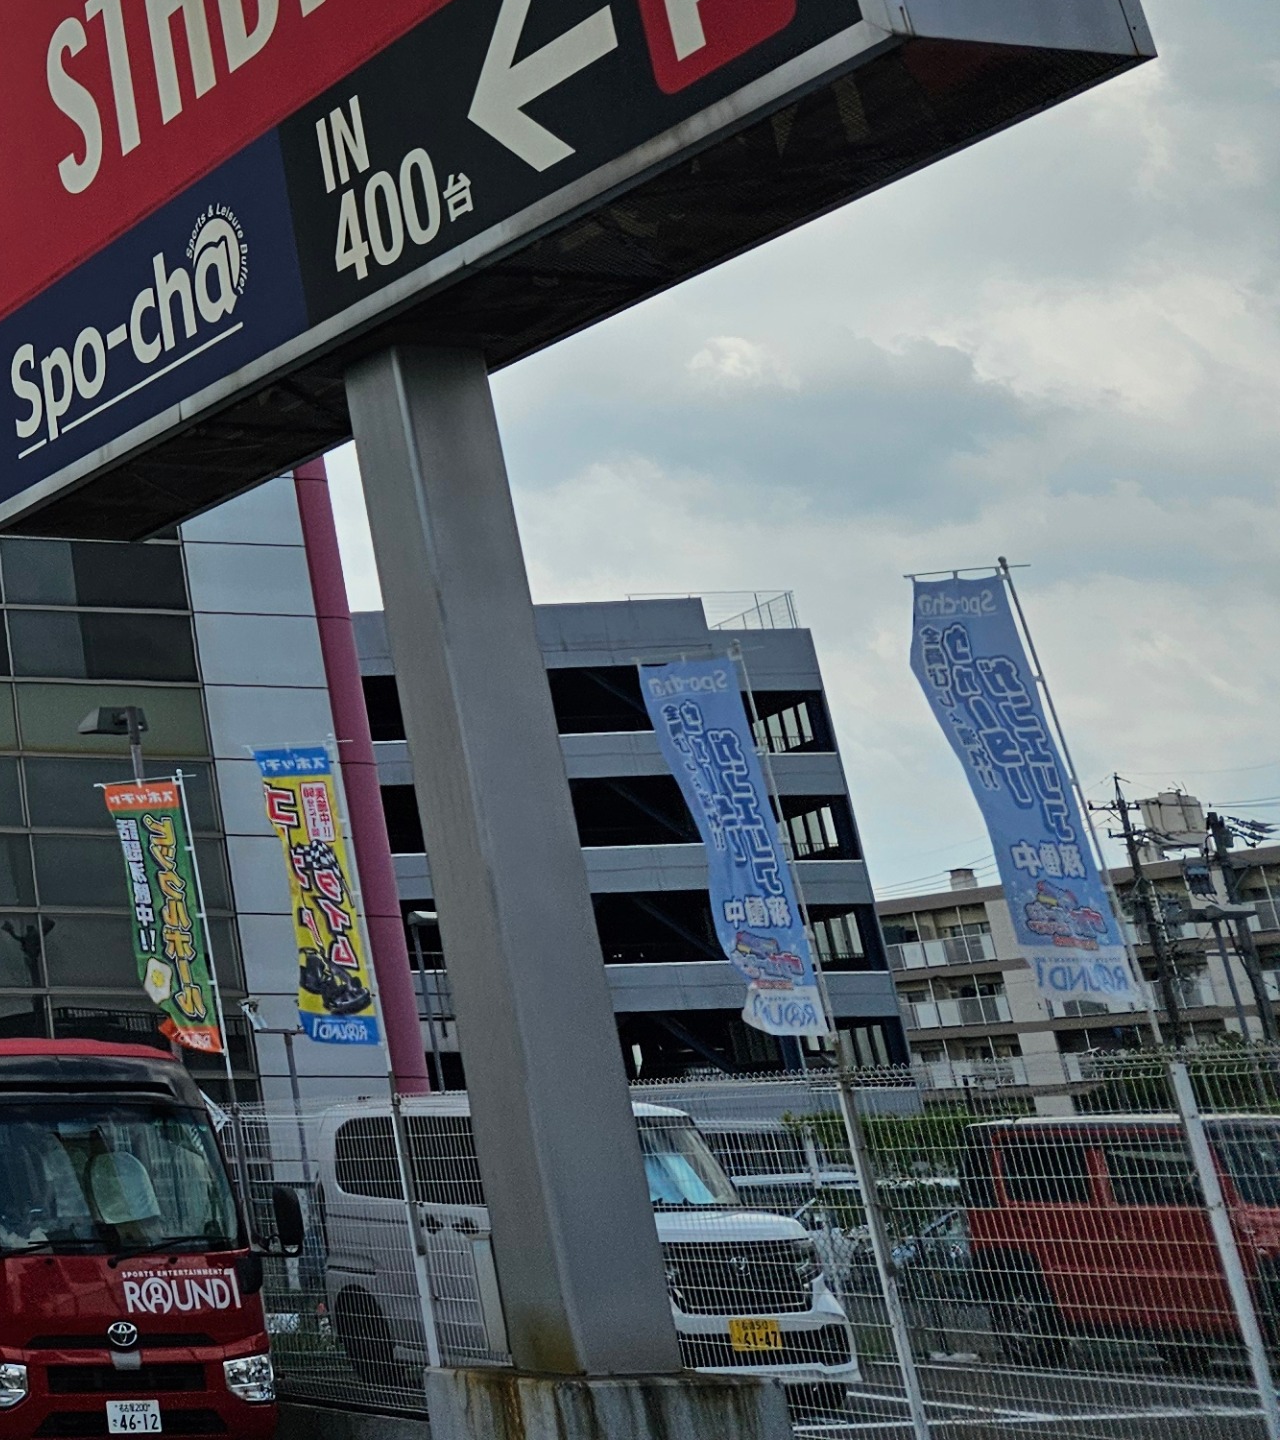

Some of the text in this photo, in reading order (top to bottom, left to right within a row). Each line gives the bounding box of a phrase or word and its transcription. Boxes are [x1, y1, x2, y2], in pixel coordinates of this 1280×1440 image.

[315, 95, 368, 194] IN
[186, 213, 206, 259] Sports
[334, 147, 475, 281] 400台
[122, 1270, 154, 1278] SPORTS
[123, 1268, 242, 1314] ROUND1
[120, 1413, 159, 1431] 46-12
